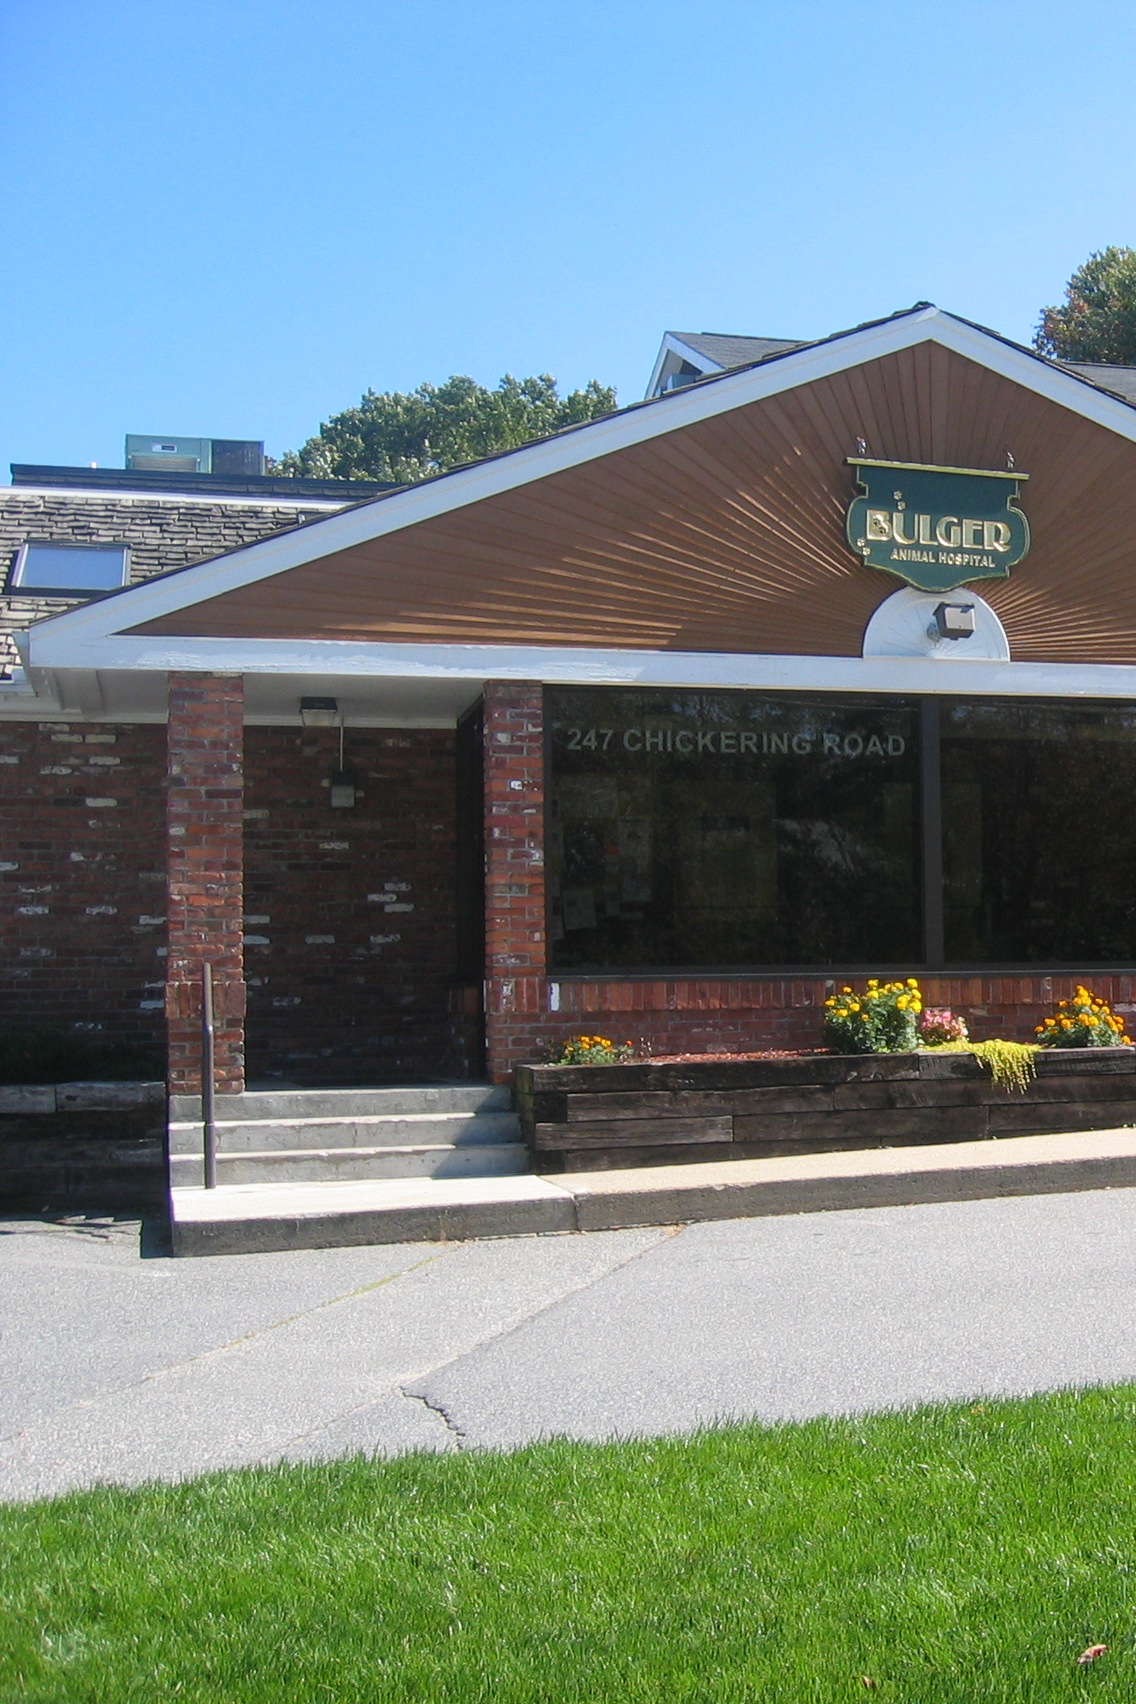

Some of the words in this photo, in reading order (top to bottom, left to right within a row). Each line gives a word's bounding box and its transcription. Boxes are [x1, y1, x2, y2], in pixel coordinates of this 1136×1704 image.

[867, 510, 1012, 552] BULGER
[890, 548, 936, 563] ANIMAL
[939, 552, 996, 568] HOSPITAL
[567, 728, 612, 751] 247
[622, 728, 812, 754] CHICKERING
[823, 732, 906, 757] ROAD
